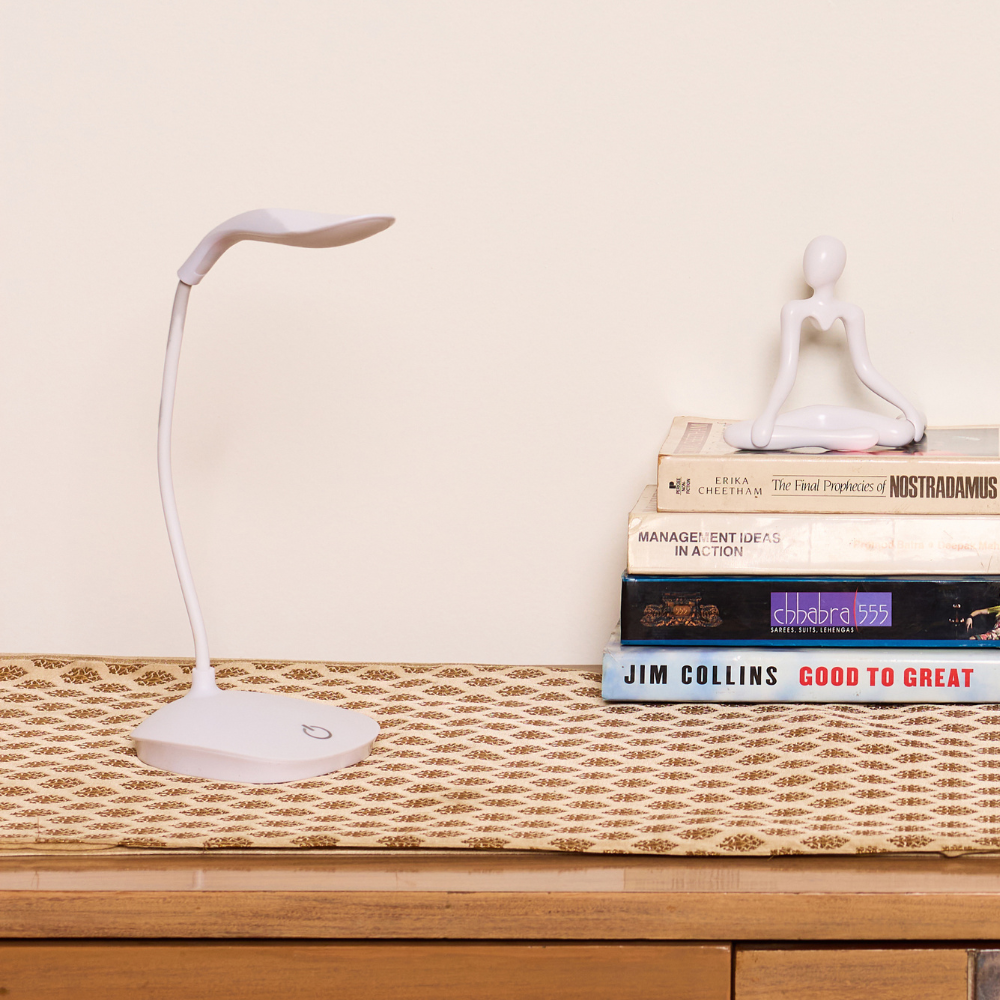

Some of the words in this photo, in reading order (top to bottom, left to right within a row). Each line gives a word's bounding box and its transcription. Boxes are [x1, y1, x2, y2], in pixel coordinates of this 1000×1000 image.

[715, 477, 749, 485] ERIKA
[772, 478, 791, 491] The
[795, 479, 820, 491] Final
[824, 479, 874, 494] Prophecies
[877, 480, 887, 494] of
[890, 475, 997, 499] NOSTRADAMUS
[698, 486, 763, 496] CHEETHAM
[638, 531, 737, 543] MANAGEMENT
[740, 532, 781, 544] IDEAS
[675, 545, 688, 556] IN
[691, 545, 743, 557] ACTION
[774, 592, 850, 625] chhabra
[859, 604, 889, 625] 555
[624, 665, 668, 684] JIM
[681, 665, 778, 686] COLLINS
[799, 666, 859, 687] GOOD
[866, 667, 895, 687] TO
[903, 667, 974, 687] GREAT
